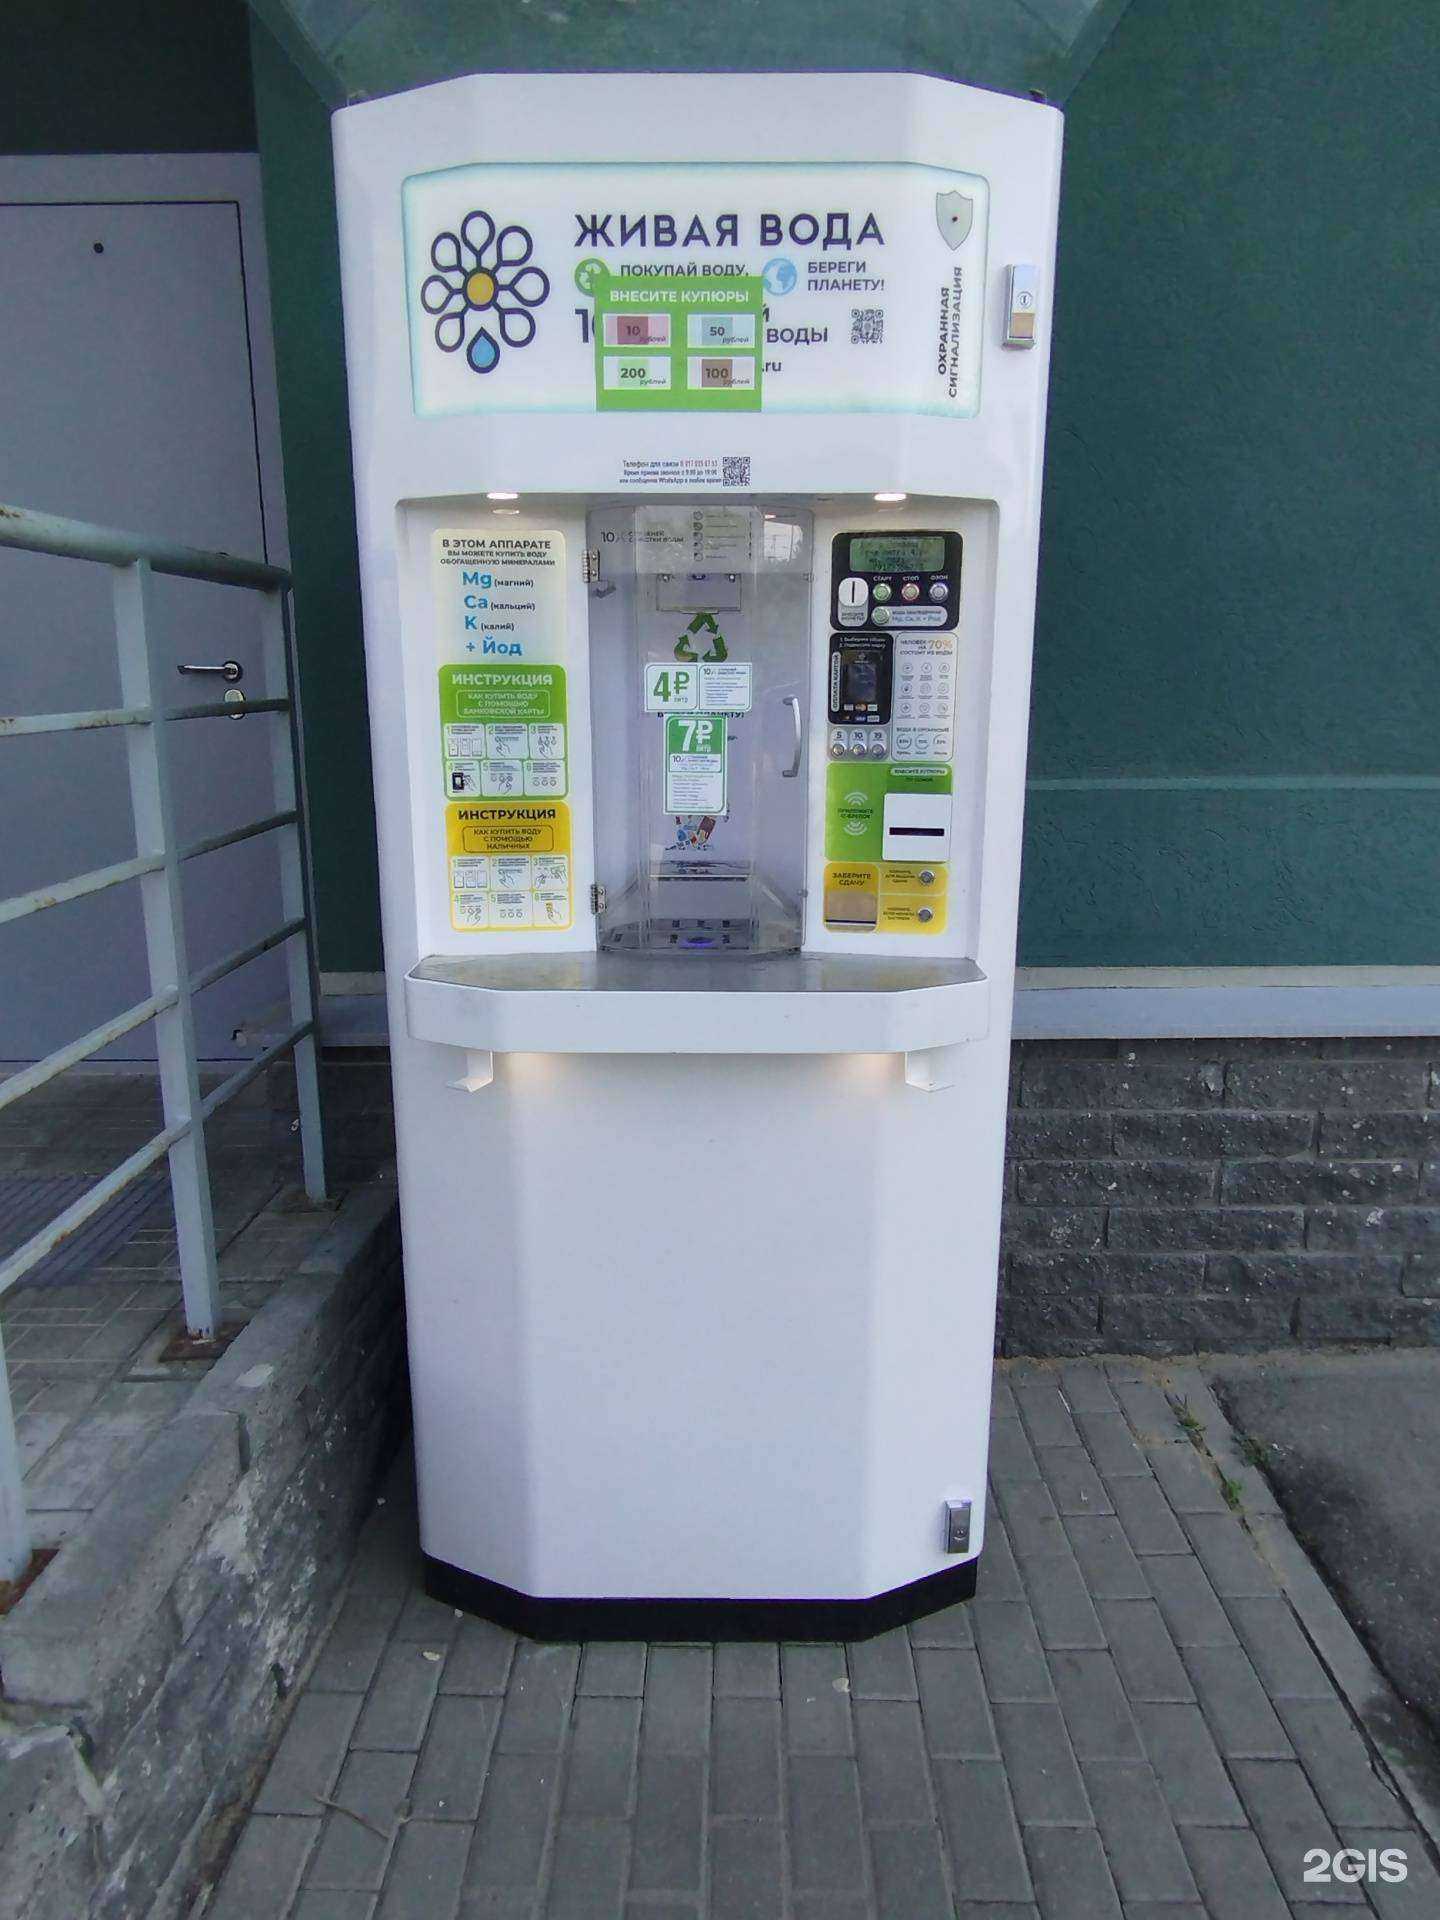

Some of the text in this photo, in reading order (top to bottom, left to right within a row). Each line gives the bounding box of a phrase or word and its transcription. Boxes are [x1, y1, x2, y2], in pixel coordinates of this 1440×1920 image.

[574, 213, 885, 251] ЖИВАЯ ВОДА
[621, 262, 697, 277] ПОКУПАЙ
[807, 261, 866, 274] БЕРЕГИ
[807, 279, 886, 292] ПЛАНЕТУ!
[610, 290, 749, 303] ВНЕСИТЕ КУПЮРЫ
[626, 326, 641, 336] 10
[709, 327, 725, 336] 50
[938, 287, 950, 375] ОХРАННАЯ
[949, 267, 963, 398] СИГНАЛИЗАЦИЯ
[621, 368, 646, 379] 200
[705, 368, 729, 379] 100
[442, 539, 551, 549] В ЭТОМ АППАРАТЕ
[462, 571, 534, 589] Mg (магний)
[464, 595, 488, 609] Ca
[482, 635, 522, 656] Йод
[452, 674, 553, 687] ИНСТРУКЦИЯ
[458, 809, 556, 820] ИНСТРУКЦИЯ
